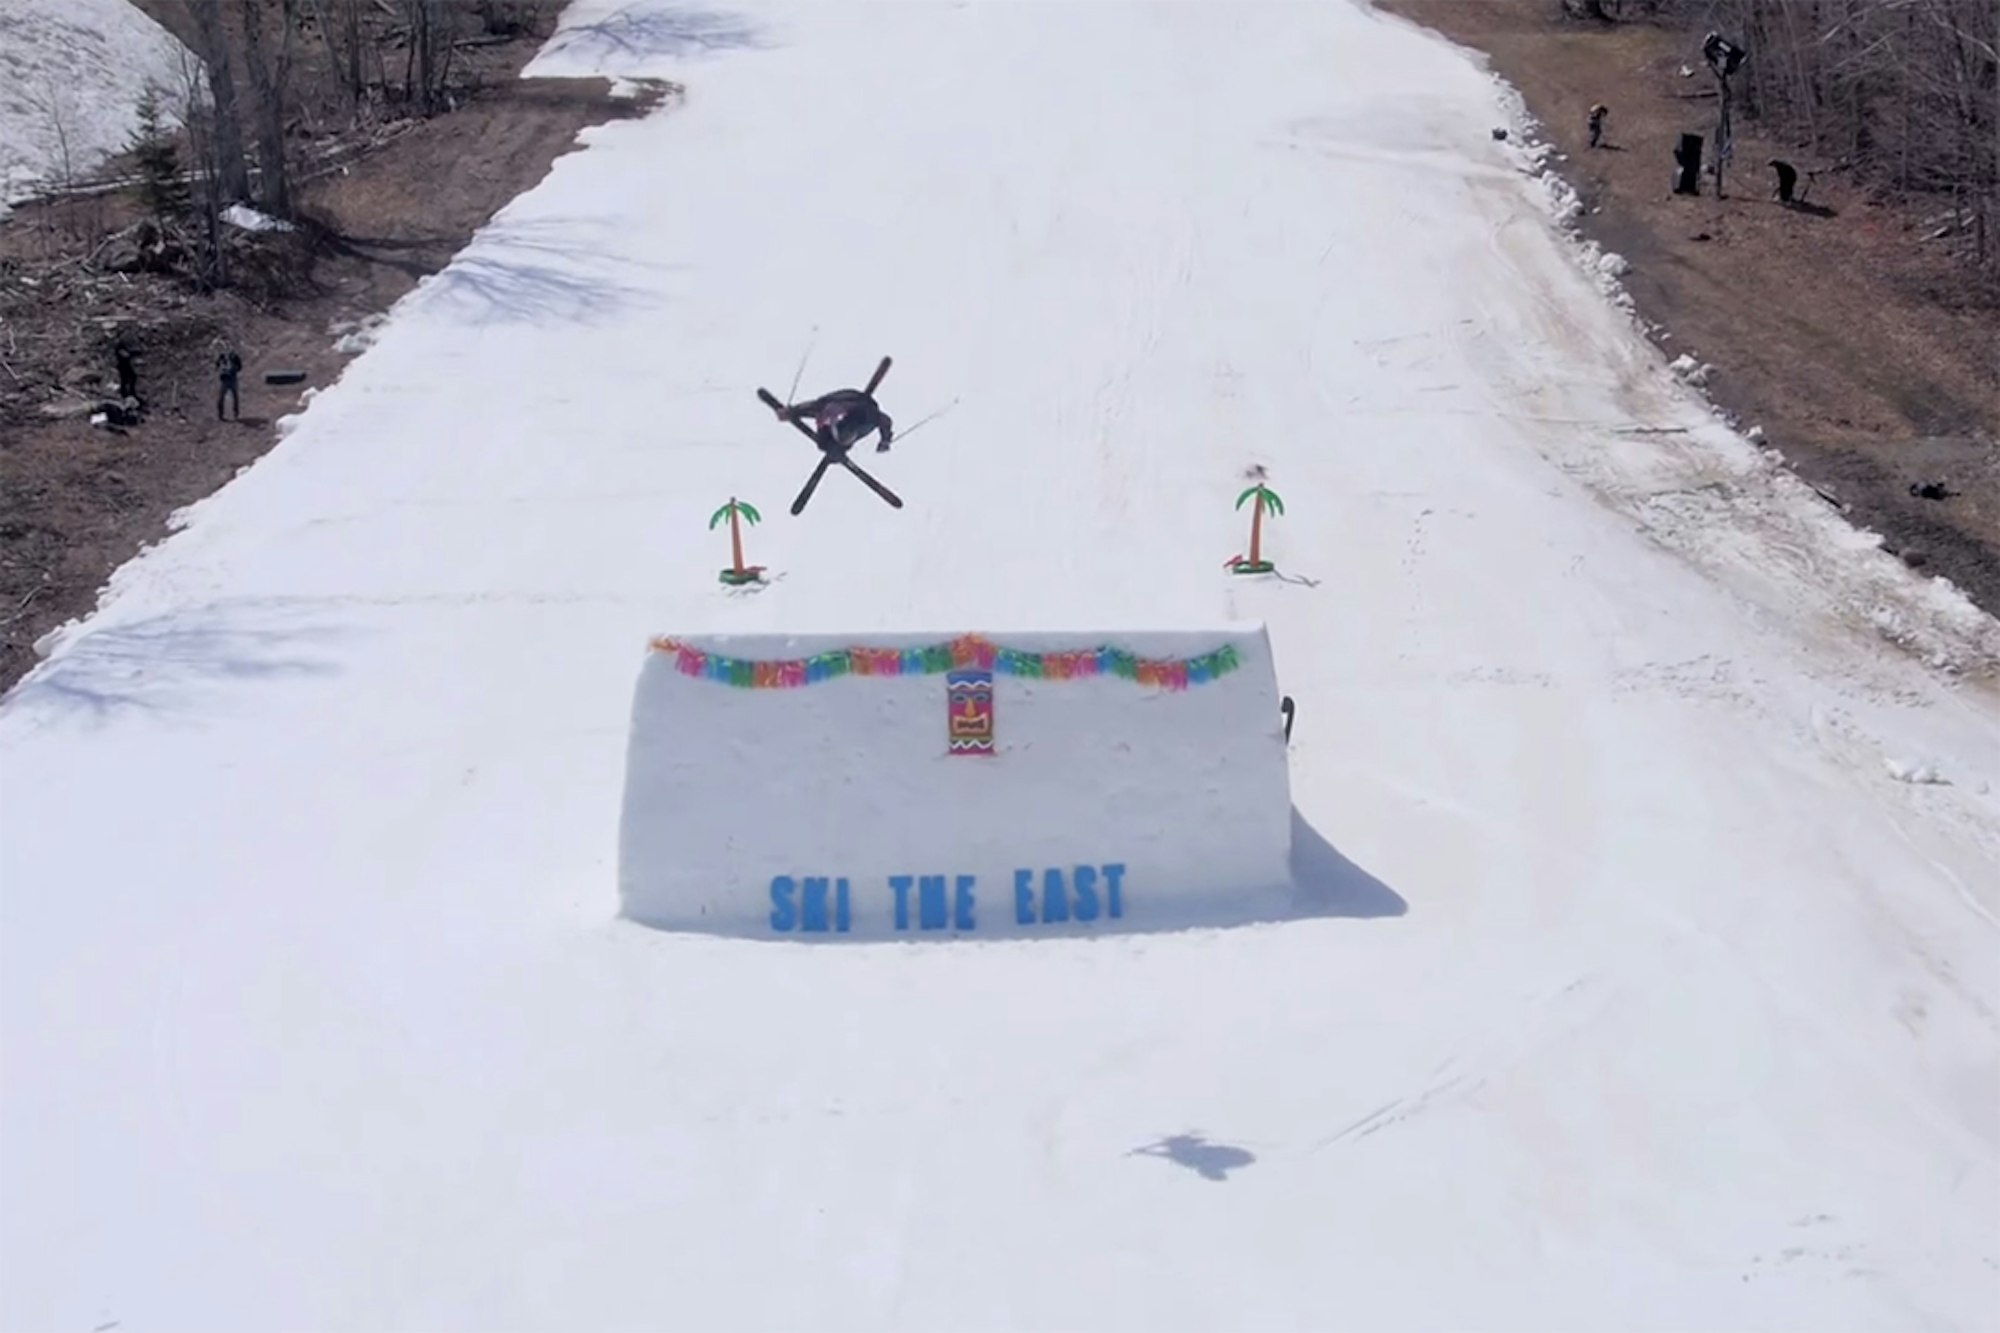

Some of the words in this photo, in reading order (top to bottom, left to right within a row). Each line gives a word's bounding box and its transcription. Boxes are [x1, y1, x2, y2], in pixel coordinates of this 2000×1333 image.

[769, 874, 850, 932] SKI
[888, 874, 976, 930] THE
[1014, 863, 1125, 924] EAST
